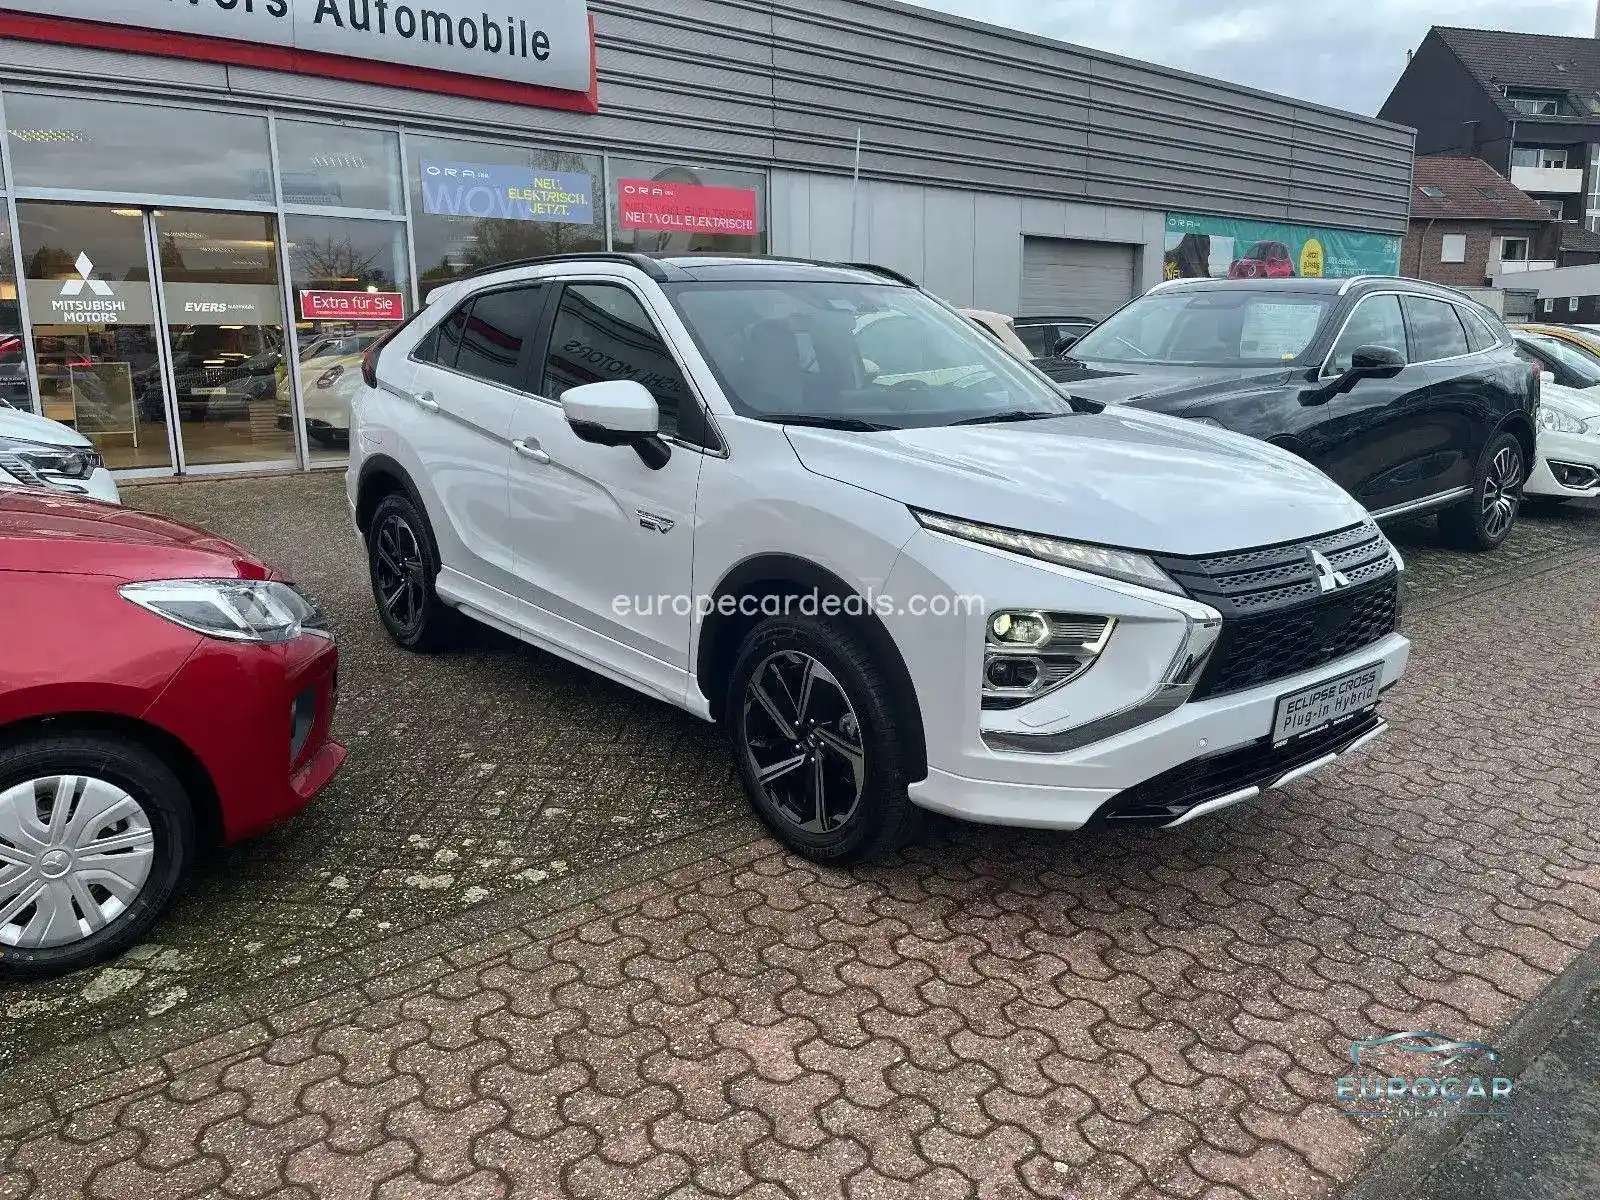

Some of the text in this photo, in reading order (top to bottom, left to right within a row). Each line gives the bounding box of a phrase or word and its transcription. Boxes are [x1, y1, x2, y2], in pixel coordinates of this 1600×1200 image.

[313, 0, 550, 61] Automobile
[427, 166, 475, 178] ORA
[508, 187, 588, 205] ELEKTRISCH.
[624, 186, 663, 196] ORA
[421, 181, 530, 219] WOW
[654, 213, 683, 225] VOLL
[685, 215, 753, 230] ELEKTRISCH!
[52, 300, 126, 311] MITSUBISHI
[184, 302, 227, 313] EVERS
[313, 296, 393, 310] Extra für Sie
[64, 312, 118, 323] MOTORS
[1287, 671, 1376, 714] ECLIPSE CROSS
[1334, 684, 1375, 712] Hybrid
